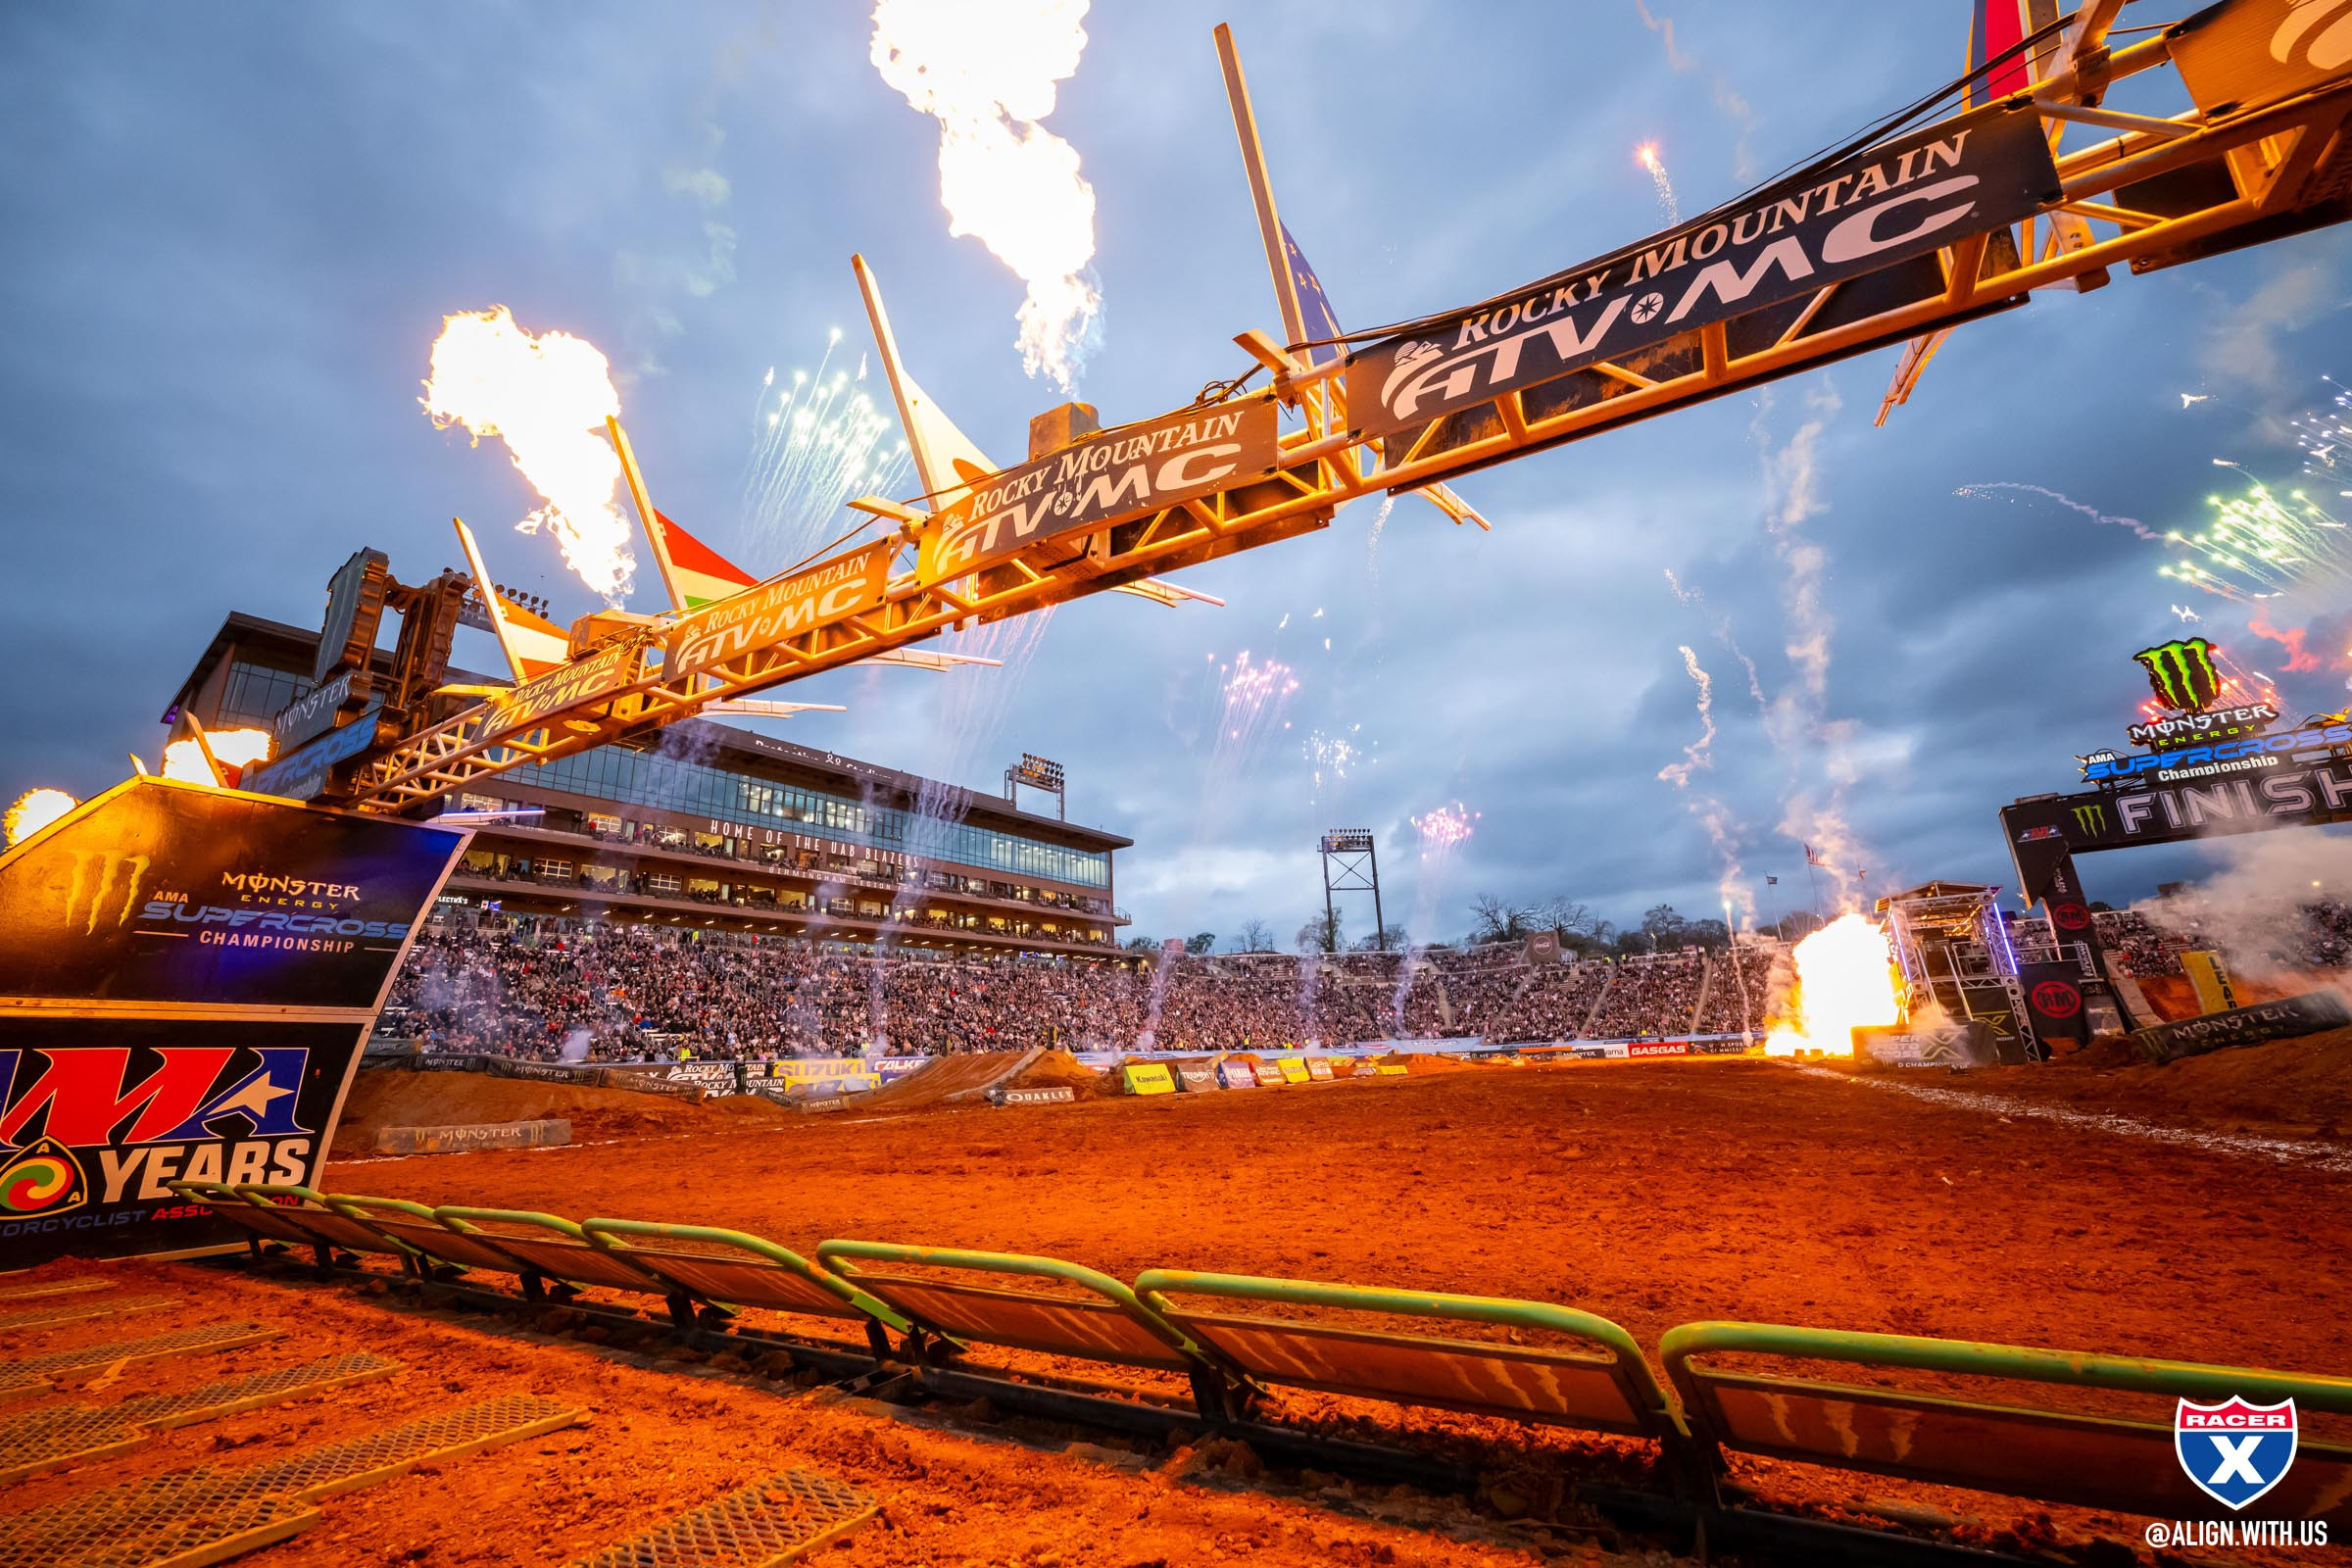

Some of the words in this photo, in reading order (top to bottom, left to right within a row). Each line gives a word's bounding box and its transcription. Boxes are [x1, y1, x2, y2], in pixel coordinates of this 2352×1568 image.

[1451, 269, 1611, 350] ROCKY
[1624, 129, 1971, 287] MOUNTAIN
[968, 466, 1050, 523] ROCKY
[1054, 411, 1244, 485] MOUNTAIN
[706, 594, 760, 630] ROCKY
[763, 552, 871, 609] MOUNTAIN
[513, 679, 552, 706] ROCKY
[554, 651, 621, 688] MOUNTAIN
[2132, 705, 2277, 739] MONSTER
[2159, 724, 2256, 746] ENERGY
[2082, 725, 2352, 782] SUPERCROSS
[2088, 753, 2115, 764] AMA
[2158, 756, 2278, 782] Championship
[710, 819, 753, 840] HOME
[765, 830, 783, 845] OF
[795, 835, 819, 852] THE
[831, 842, 856, 858] UAB
[865, 848, 919, 868] BLAZERS
[221, 871, 361, 902] MONSTER
[768, 866, 847, 884] BIRMINGHAM
[854, 879, 891, 891] LEGION
[153, 890, 189, 904] AMA
[241, 894, 340, 910] ENERGY
[437, 896, 468, 905] LECTRA'S
[138, 902, 413, 940] SUPERCROSS
[200, 930, 355, 954] CHAMPIONSHIP
[2173, 1004, 2300, 1040] MONSTER
[1631, 1045, 1687, 1055] GASGAS
[425, 1057, 465, 1067] MONSTER
[514, 1064, 568, 1079] MONSTER
[684, 1064, 716, 1073] ROCKY
[717, 1063, 765, 1072] MOTAIN
[778, 1062, 862, 1076] SUZUKI
[874, 1060, 927, 1071] FALKE
[1136, 1073, 1167, 1083] Kawasaki
[1025, 1090, 1072, 1102] OAKLEY
[439, 1126, 522, 1143] MONSTER
[99, 1139, 310, 1203] YEARS
